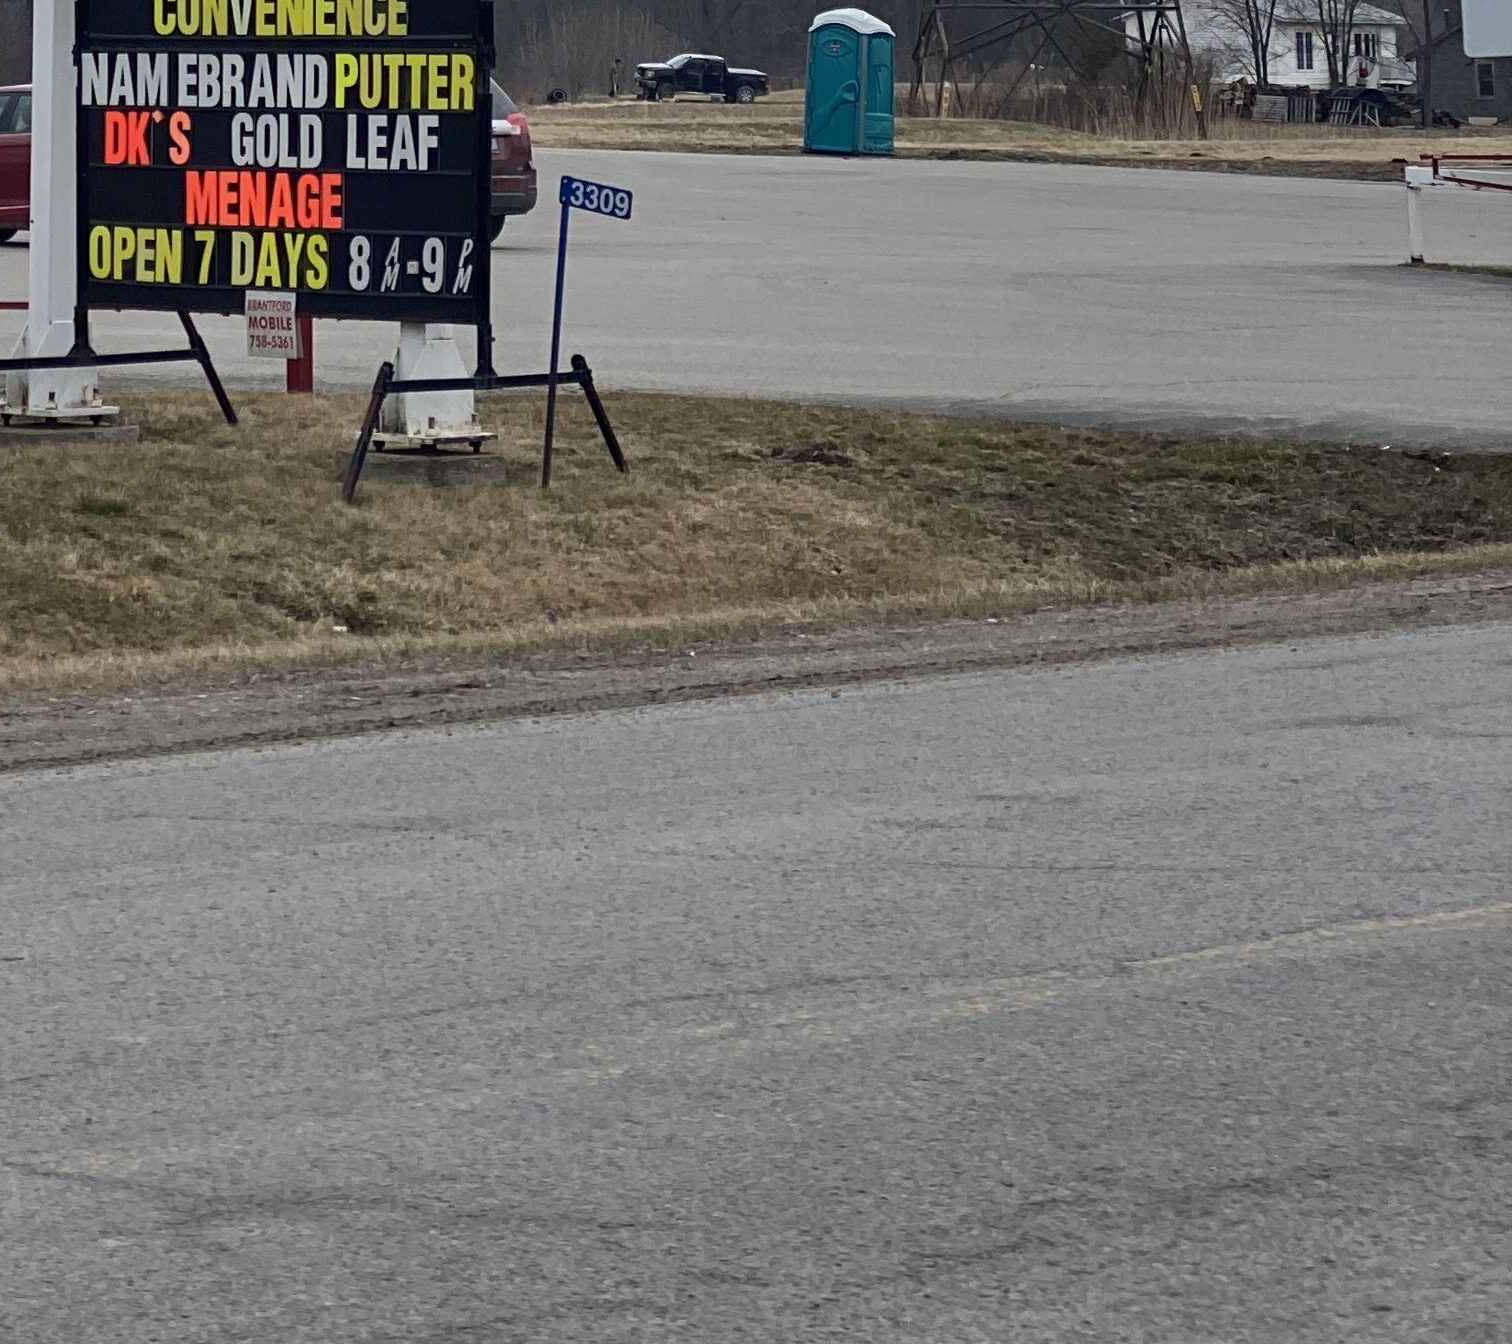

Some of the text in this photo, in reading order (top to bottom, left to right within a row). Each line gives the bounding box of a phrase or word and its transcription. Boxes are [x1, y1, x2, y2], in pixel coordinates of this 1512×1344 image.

[335, 54, 475, 110] PUTTER
[231, 114, 323, 168] GOLD
[346, 115, 439, 170] LEAF
[186, 171, 343, 229] MENAGE
[570, 181, 629, 217] 3309
[89, 226, 181, 284] OPEN
[195, 231, 216, 285] 7
[231, 232, 329, 289] DAYS
[249, 317, 292, 330] MOBILE
